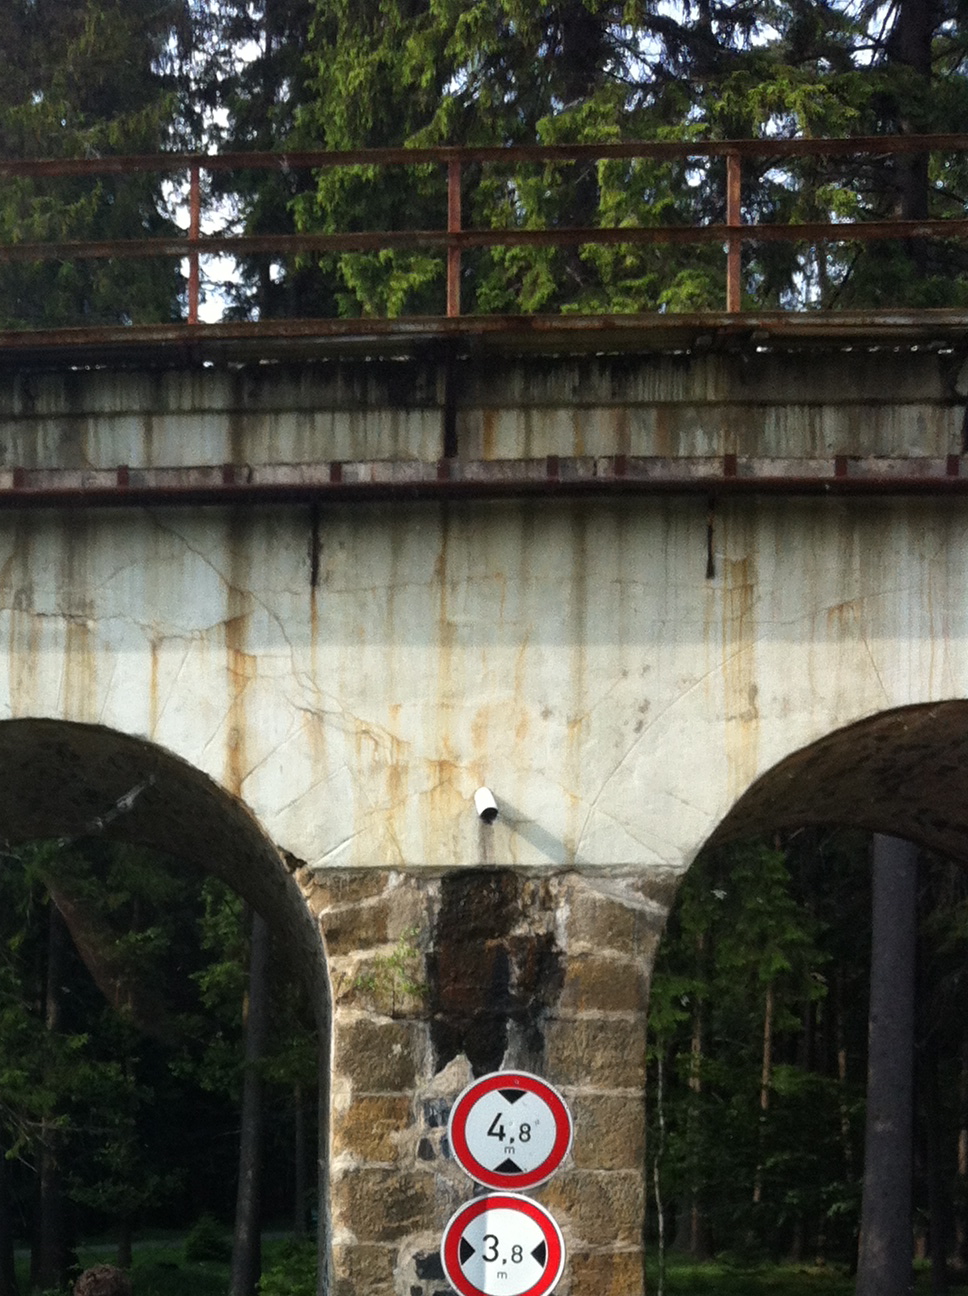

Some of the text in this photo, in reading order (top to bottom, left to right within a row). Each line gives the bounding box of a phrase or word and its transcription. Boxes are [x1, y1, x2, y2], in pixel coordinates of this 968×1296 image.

[487, 1112, 531, 1144] 4,8
[504, 1145, 515, 1154] m
[482, 1234, 523, 1264] 3,8
[496, 1271, 508, 1279] m
